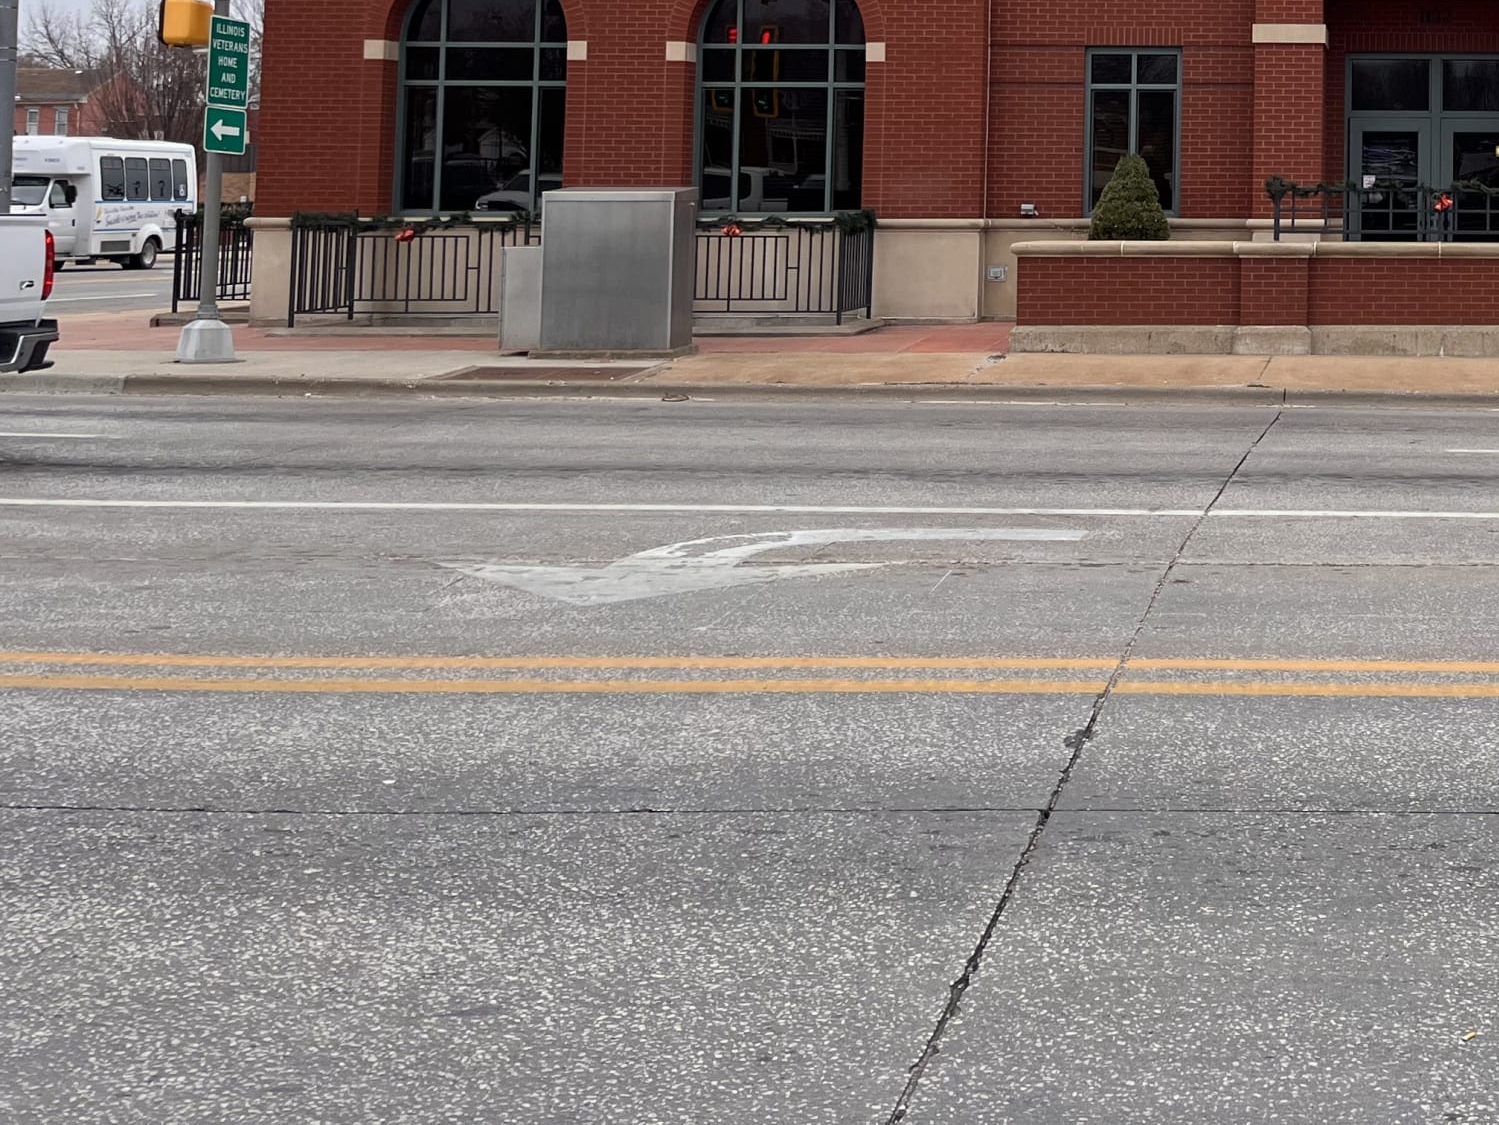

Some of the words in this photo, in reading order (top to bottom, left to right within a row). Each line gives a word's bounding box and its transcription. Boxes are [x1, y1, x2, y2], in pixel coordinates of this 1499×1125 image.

[216, 23, 245, 38] ILLINOIS
[212, 38, 248, 54] VETERANS
[218, 55, 238, 69] HOME
[220, 72, 236, 84] AND
[209, 86, 246, 101] CEMETERY
